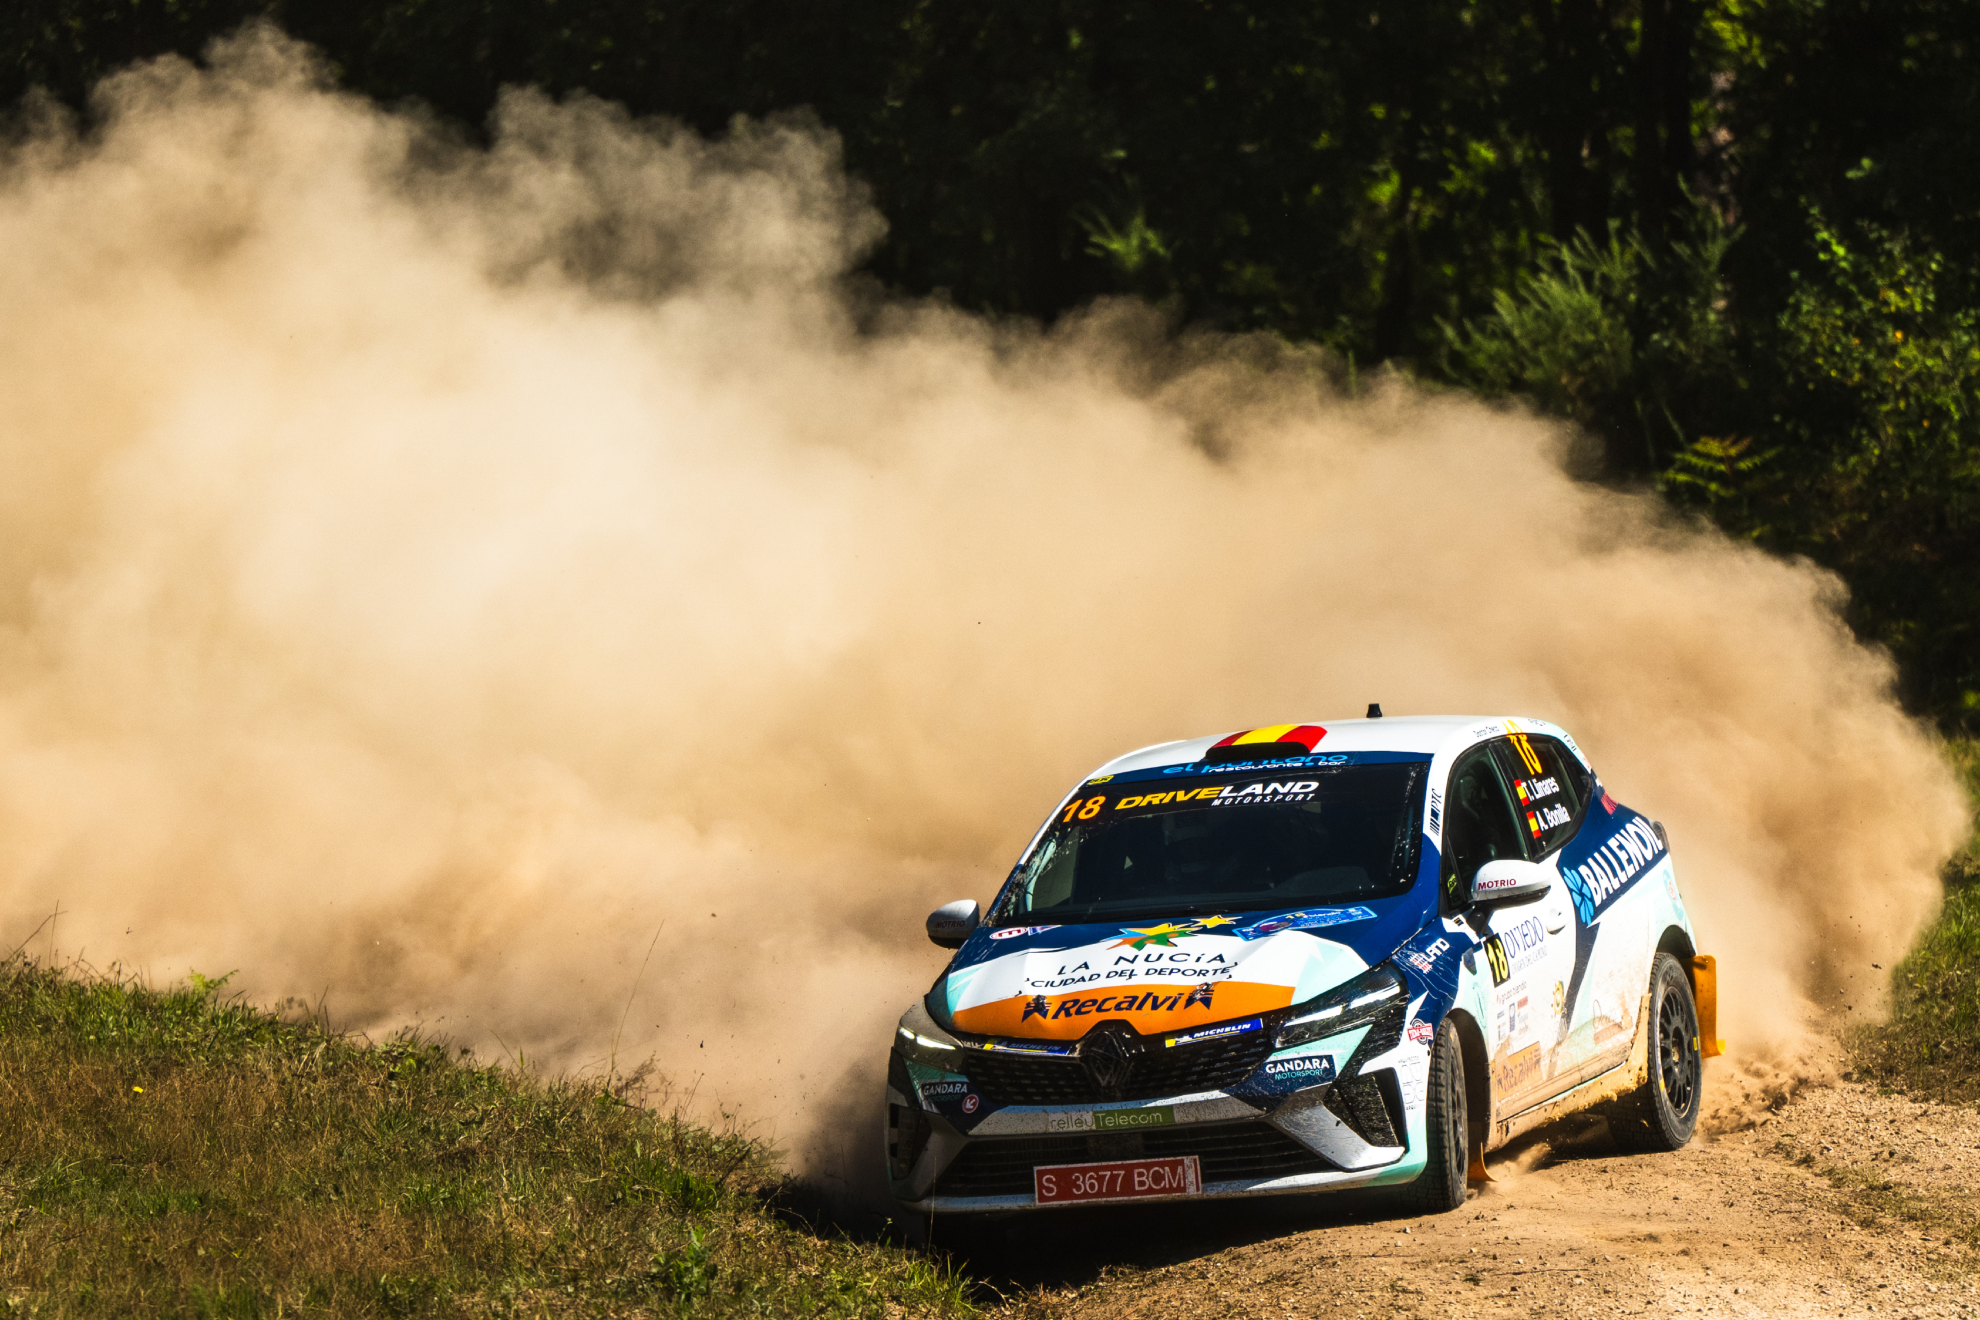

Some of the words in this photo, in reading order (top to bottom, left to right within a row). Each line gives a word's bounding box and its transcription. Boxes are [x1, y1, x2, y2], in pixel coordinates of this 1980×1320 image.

[1163, 763, 1194, 774] el
[1115, 781, 1319, 810] DRIVELAND
[1211, 793, 1315, 806] MOTORSPORT
[1063, 795, 1106, 823] 18
[1578, 816, 1664, 907] BALLENOIL
[1478, 879, 1516, 890] MOTRIO
[936, 920, 965, 929] MOTRIO
[1504, 916, 1544, 958] OVIEDO
[1057, 961, 1090, 975] LA
[1487, 938, 1509, 983] 18
[1031, 973, 1101, 987] CIUDAD
[1106, 968, 1138, 980] DEL
[1145, 966, 1230, 977] DEPORTE
[1051, 992, 1185, 1019] Recalvi
[1193, 1023, 1251, 1038] MICHELIN
[1009, 1042, 1061, 1051] MICHELIN
[1266, 1058, 1330, 1074] GANDARA
[1275, 1069, 1323, 1080] MOTORSPORT
[924, 1083, 967, 1096] GANDARA
[1042, 1175, 1057, 1197] S
[1072, 1170, 1125, 1195] 3677
[1134, 1165, 1184, 1191] BCM
